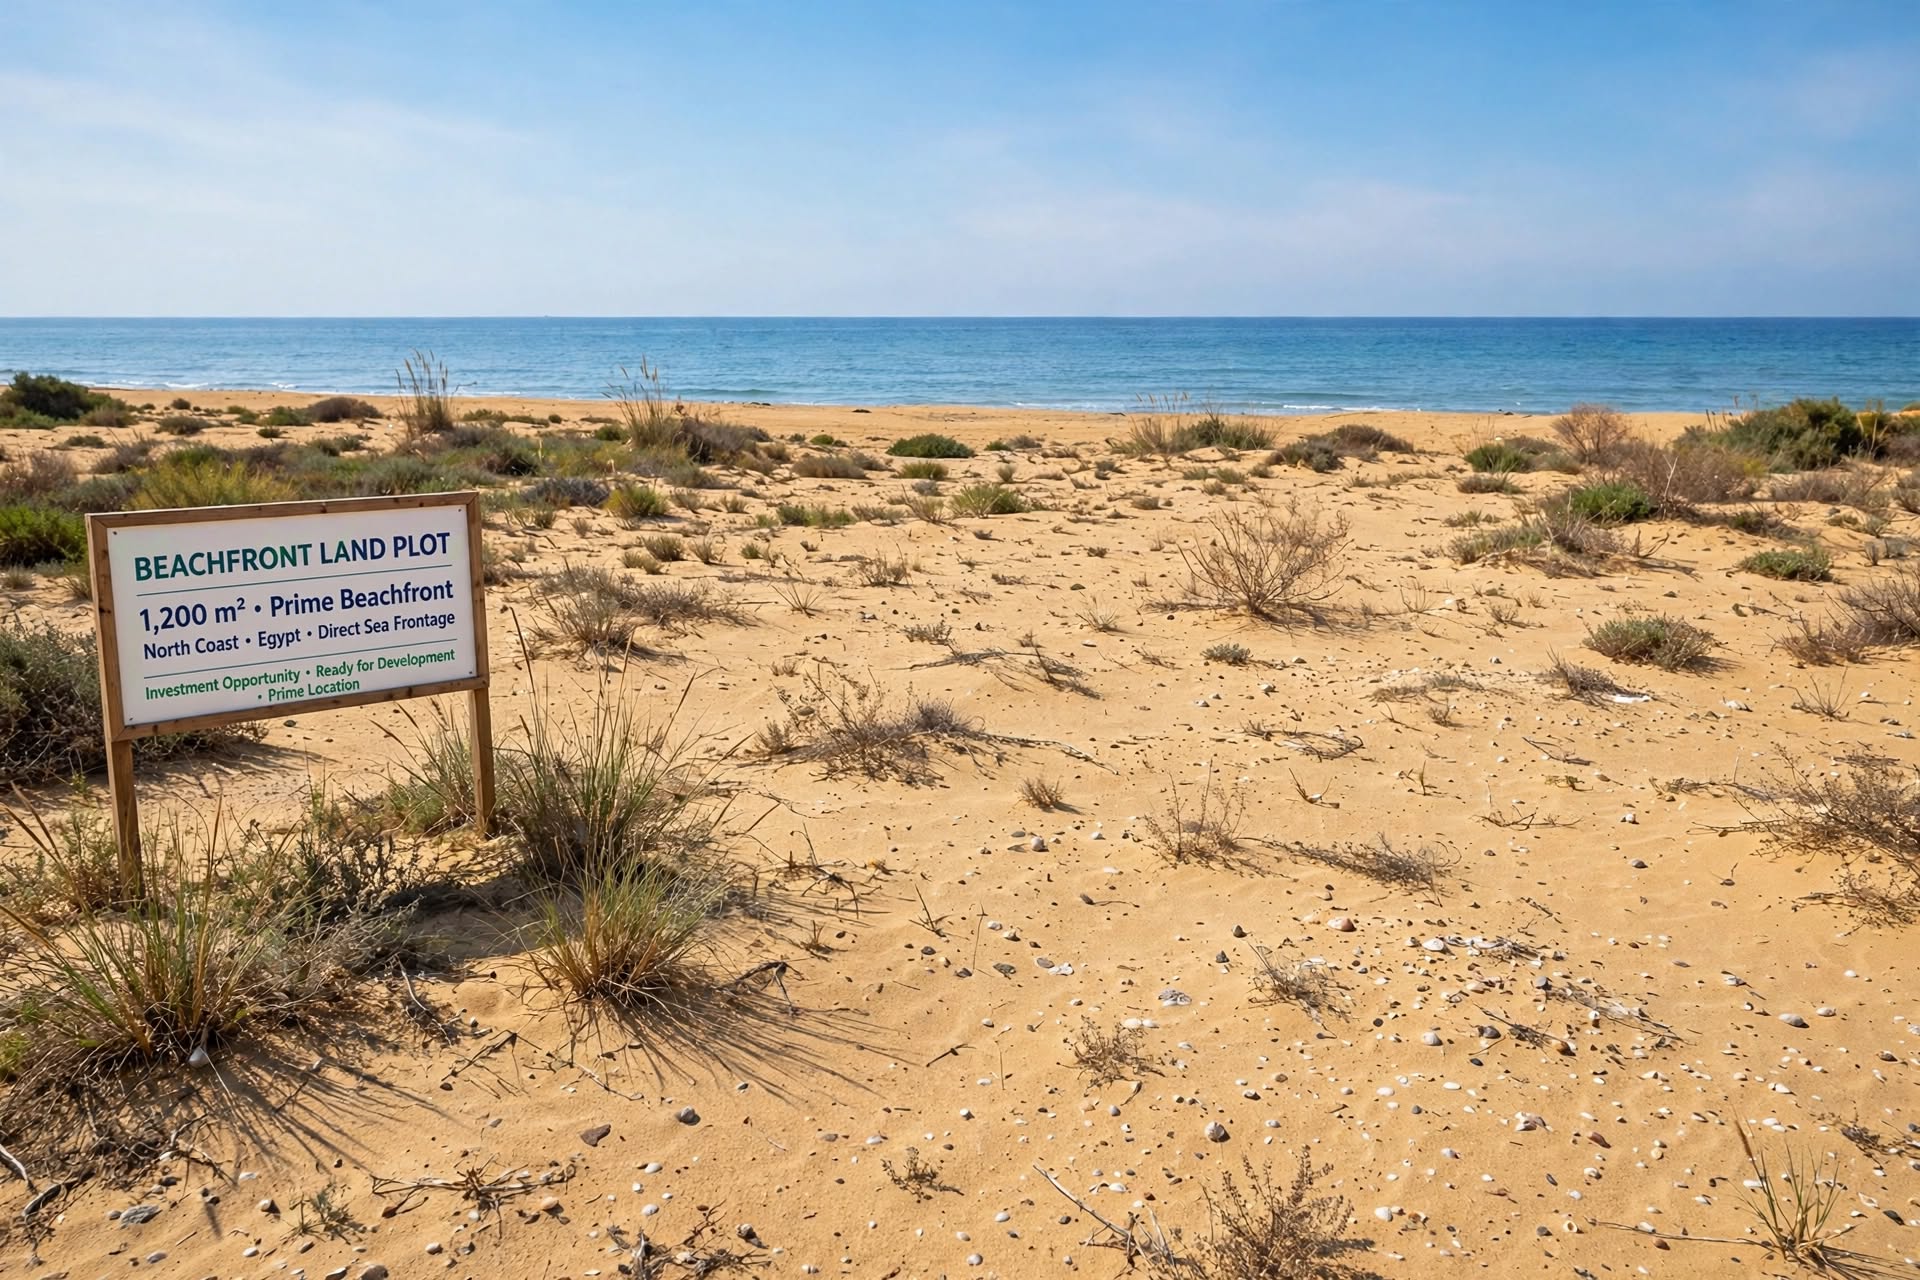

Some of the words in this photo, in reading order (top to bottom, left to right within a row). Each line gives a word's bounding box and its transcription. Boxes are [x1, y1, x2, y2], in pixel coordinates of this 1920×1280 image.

[134, 543, 313, 582] BEACHFRONT
[319, 537, 386, 565] LAND
[392, 531, 451, 559] PLOT
[139, 603, 208, 636] 1,200
[269, 592, 334, 618] Prime
[340, 579, 454, 610] Beachfront
[143, 639, 191, 660] North
[194, 635, 240, 654] Coast
[257, 628, 302, 650] Egypt
[318, 621, 361, 640] Direct
[363, 618, 390, 635] Sea
[393, 613, 456, 631] Frontage
[145, 678, 220, 701] Investment
[222, 668, 301, 691] Opportunity
[316, 660, 354, 678] Ready
[356, 658, 375, 673] for
[377, 648, 456, 670] Development
[268, 686, 305, 703] Prime
[307, 678, 360, 696] Location
